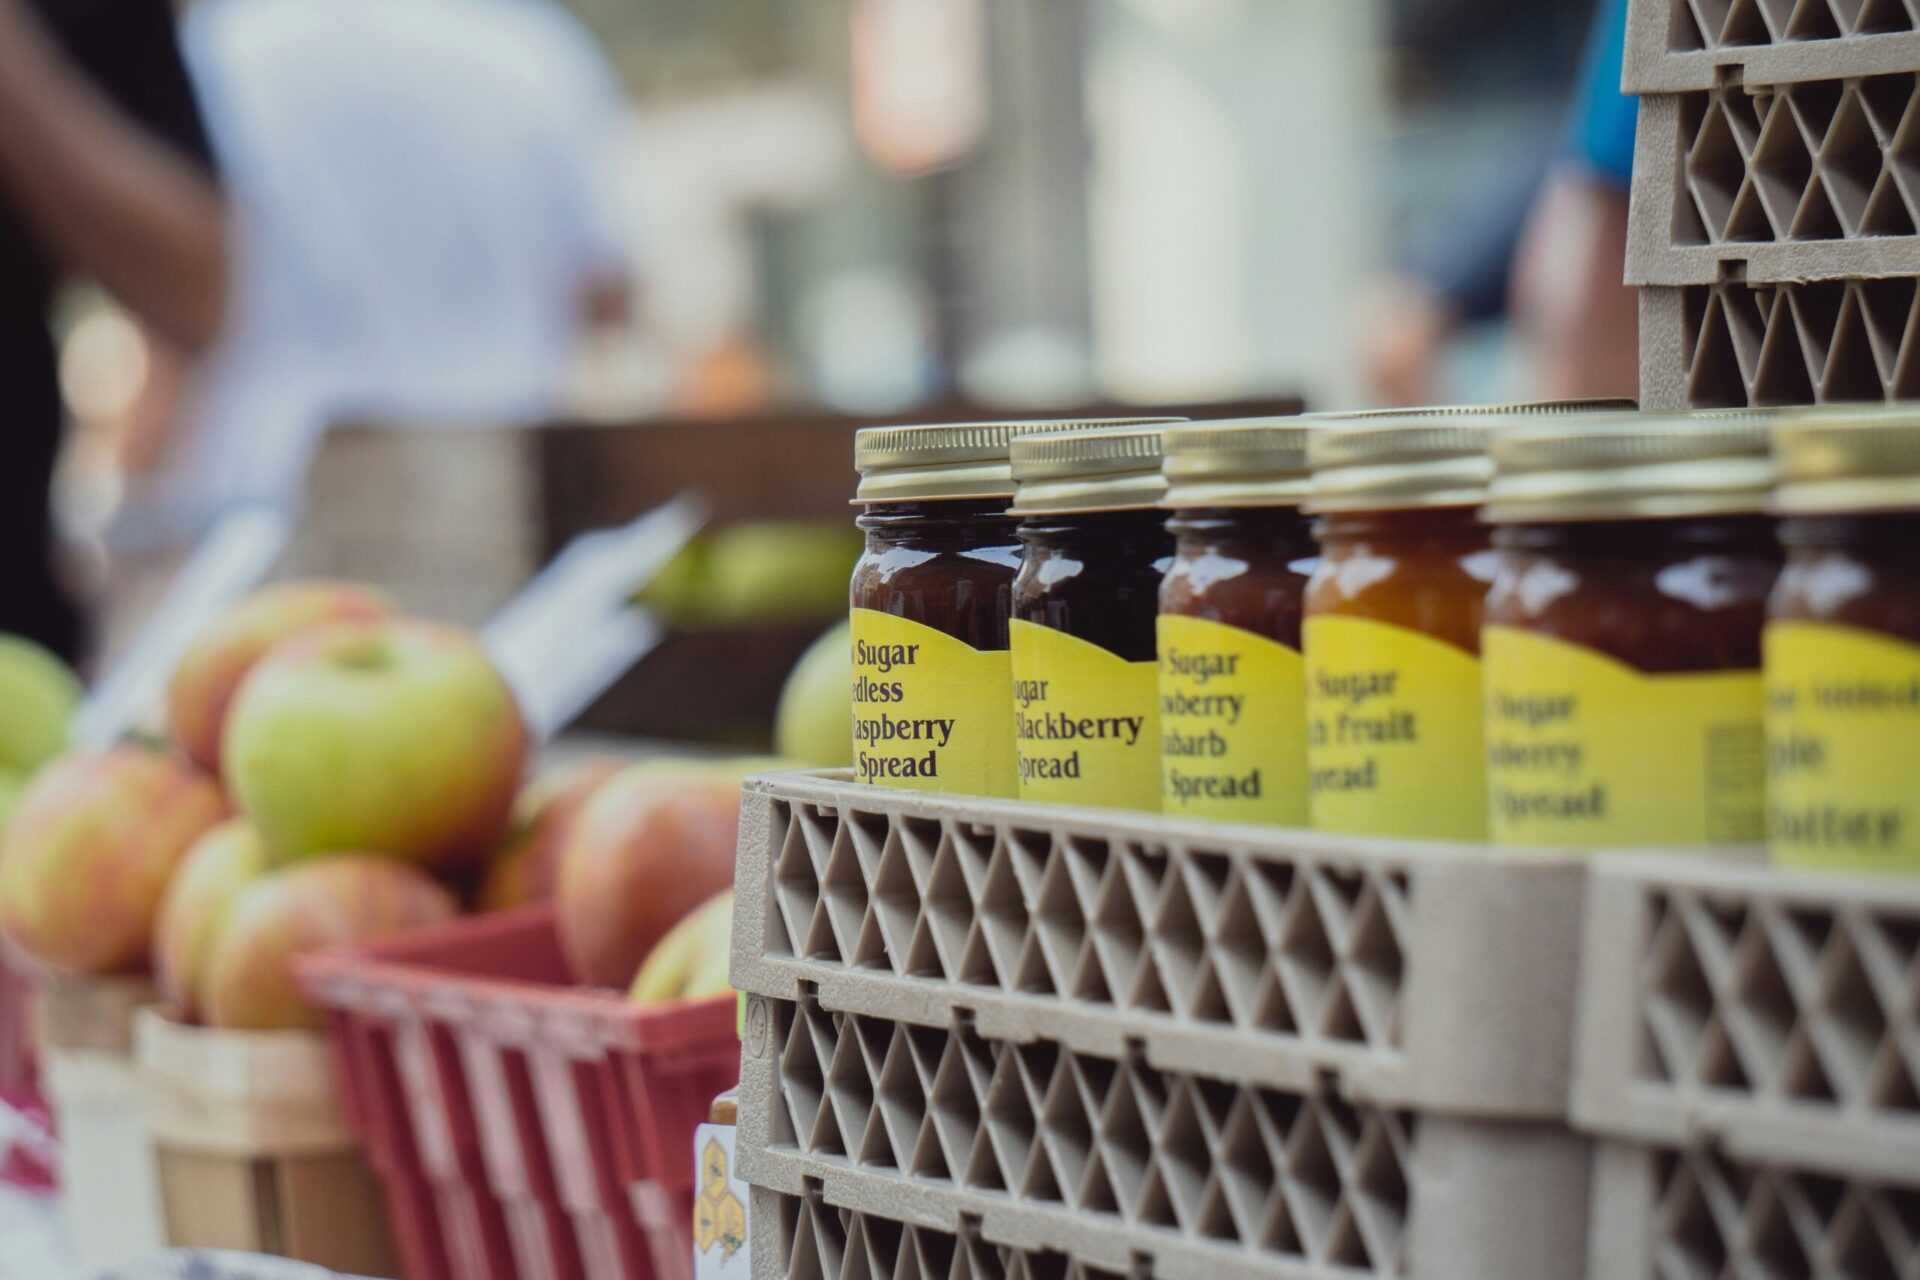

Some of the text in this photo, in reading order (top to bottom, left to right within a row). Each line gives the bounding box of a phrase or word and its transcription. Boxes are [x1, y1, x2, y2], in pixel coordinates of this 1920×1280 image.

[858, 639, 920, 673] Sugar
[1168, 648, 1240, 684] Sugar
[860, 750, 938, 785] Spread
[1170, 768, 1261, 804] Spread
